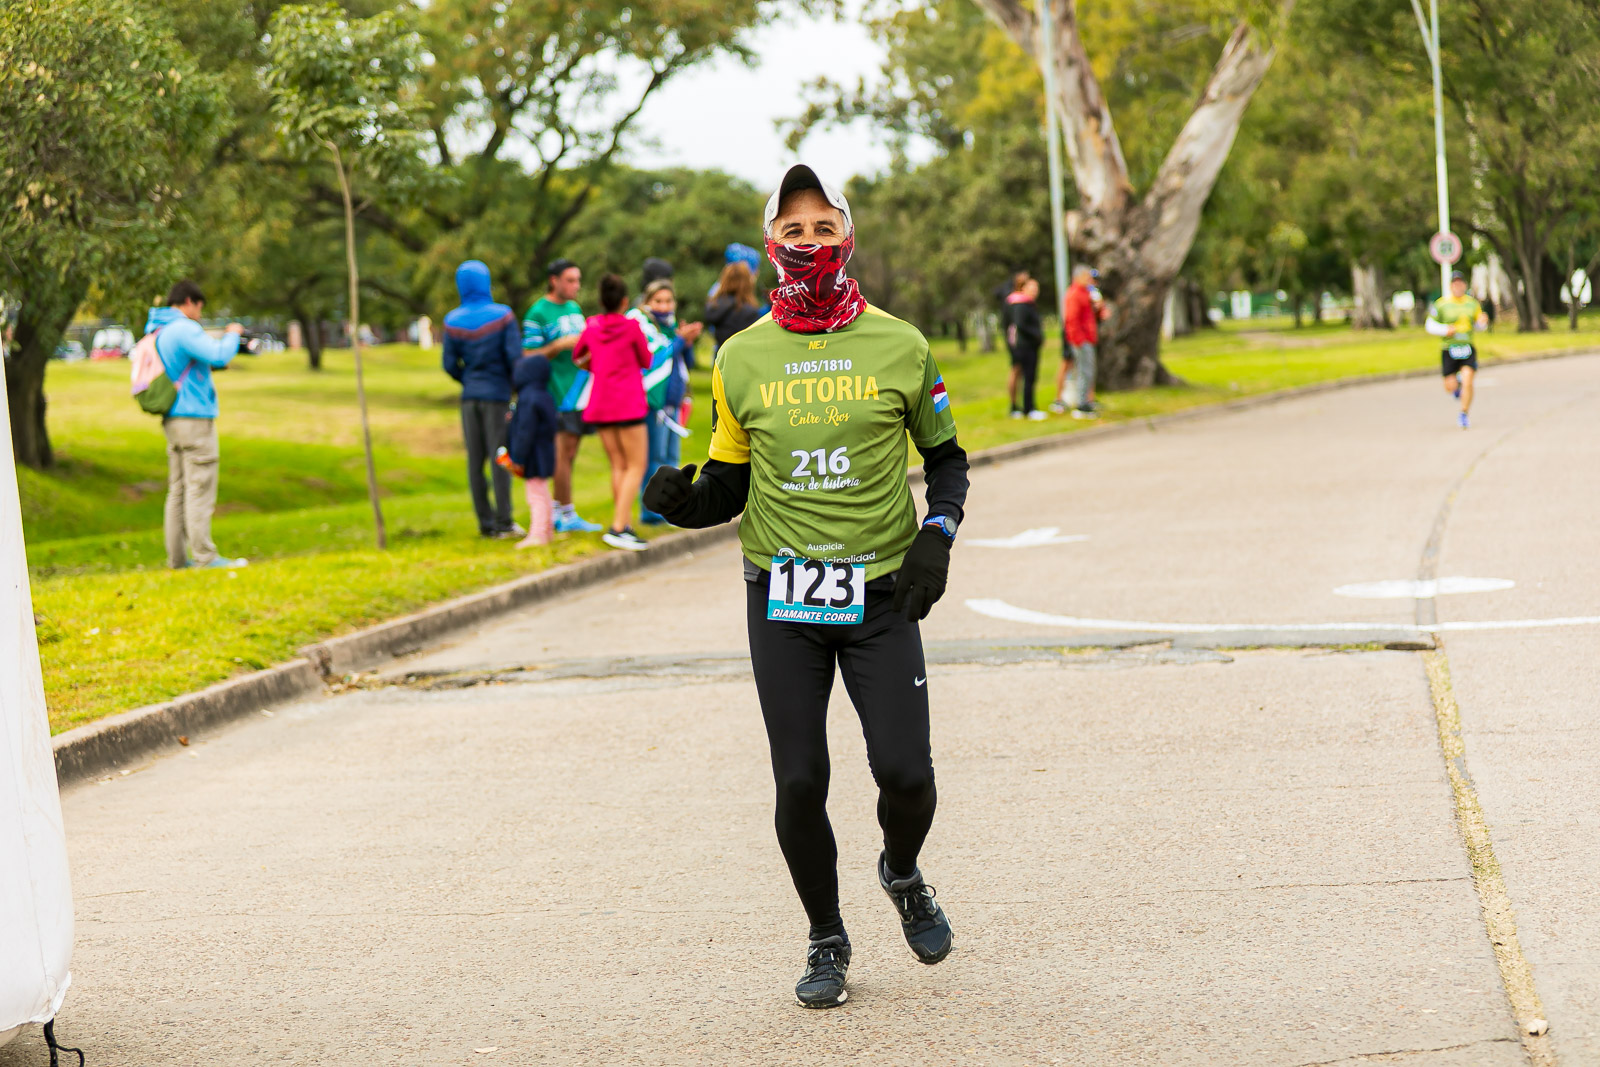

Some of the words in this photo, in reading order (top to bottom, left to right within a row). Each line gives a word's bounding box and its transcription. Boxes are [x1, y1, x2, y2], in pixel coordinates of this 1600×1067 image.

[784, 359, 853, 375] 13/05/1810
[759, 375, 880, 409] VICTORIA
[788, 408, 822, 427] Entre
[790, 446, 851, 478] 216
[808, 476, 821, 491] de
[823, 475, 861, 489] historia
[807, 543, 845, 552] Auspicia:
[779, 558, 855, 610] 123
[772, 608, 822, 620] DIAMANTE
[824, 612, 858, 622] CORRE
